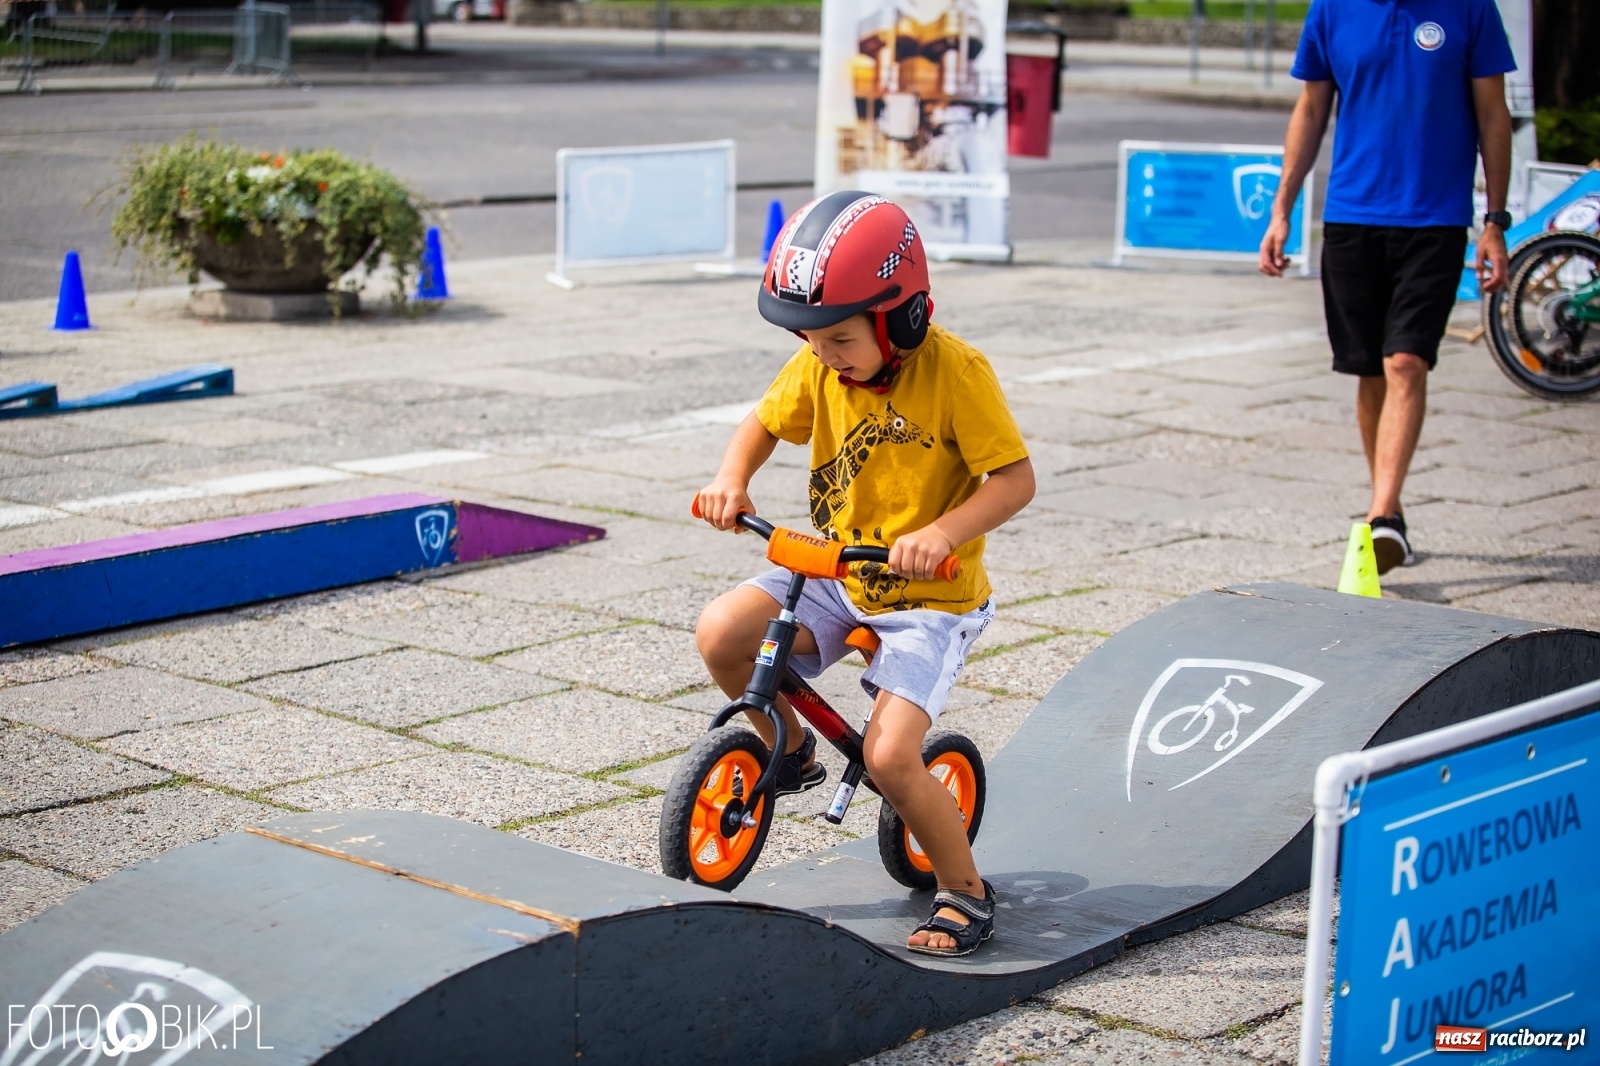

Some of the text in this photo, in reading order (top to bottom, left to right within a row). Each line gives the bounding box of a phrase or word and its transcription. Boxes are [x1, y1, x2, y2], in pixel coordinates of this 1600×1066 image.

[786, 531, 828, 548] KETTLER
[1391, 791, 1582, 896] ROWEROWA
[1382, 877, 1558, 978] AKADEMIA
[1380, 962, 1527, 1054] JUNIORA
